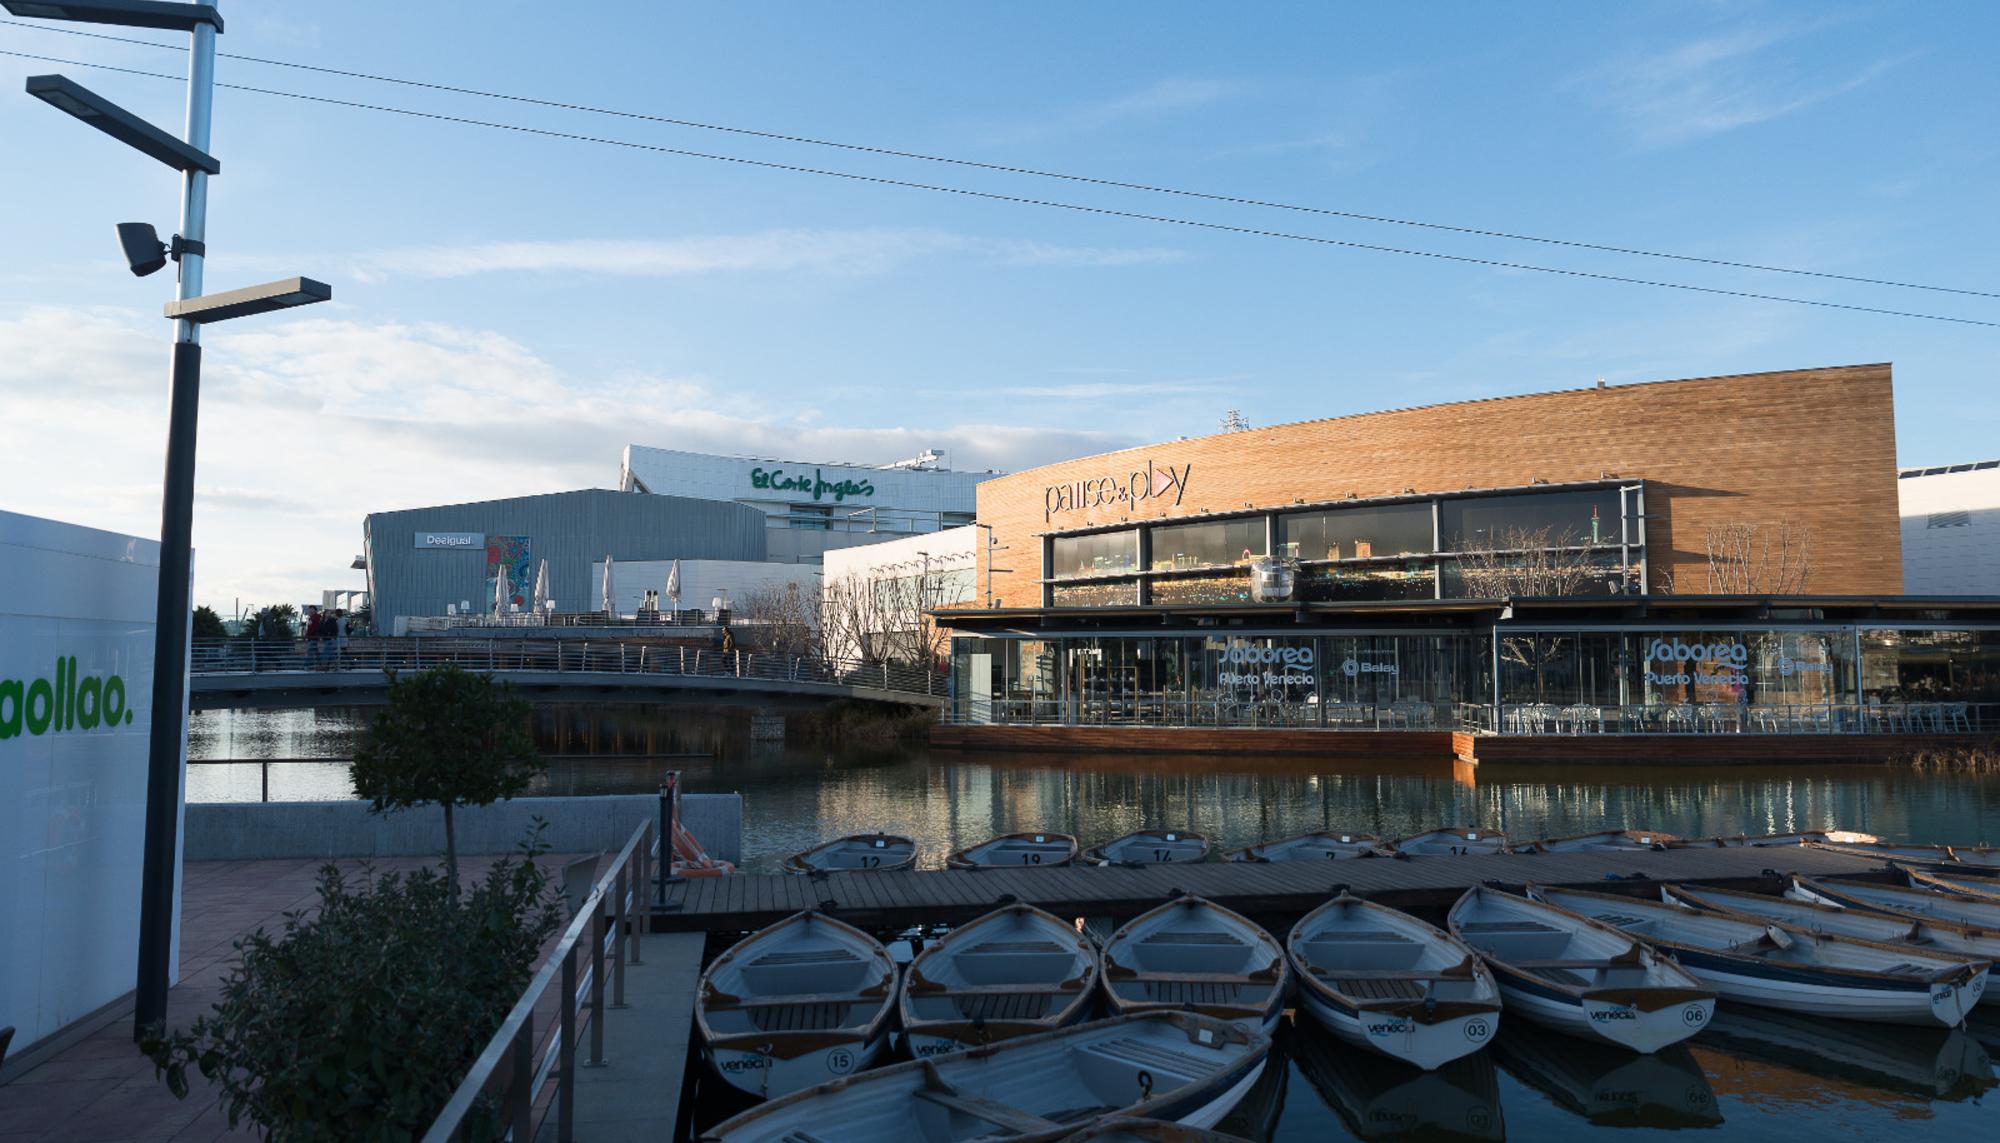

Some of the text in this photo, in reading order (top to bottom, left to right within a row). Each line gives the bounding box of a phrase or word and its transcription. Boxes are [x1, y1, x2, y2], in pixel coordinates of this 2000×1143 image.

[751, 467, 874, 501] El Corte Inglés
[1646, 638, 1748, 662] Saborea
[1219, 671, 1314, 685] Puerto Venecia
[1646, 671, 1749, 685] Puerto Venecia
[861, 856, 880, 868] 12
[1021, 853, 1041, 865] 19
[1685, 1010, 1703, 1022] 06
[1467, 1025, 1486, 1036] 03
[833, 1055, 849, 1068] 15
[1138, 1071, 1153, 1098] 9
